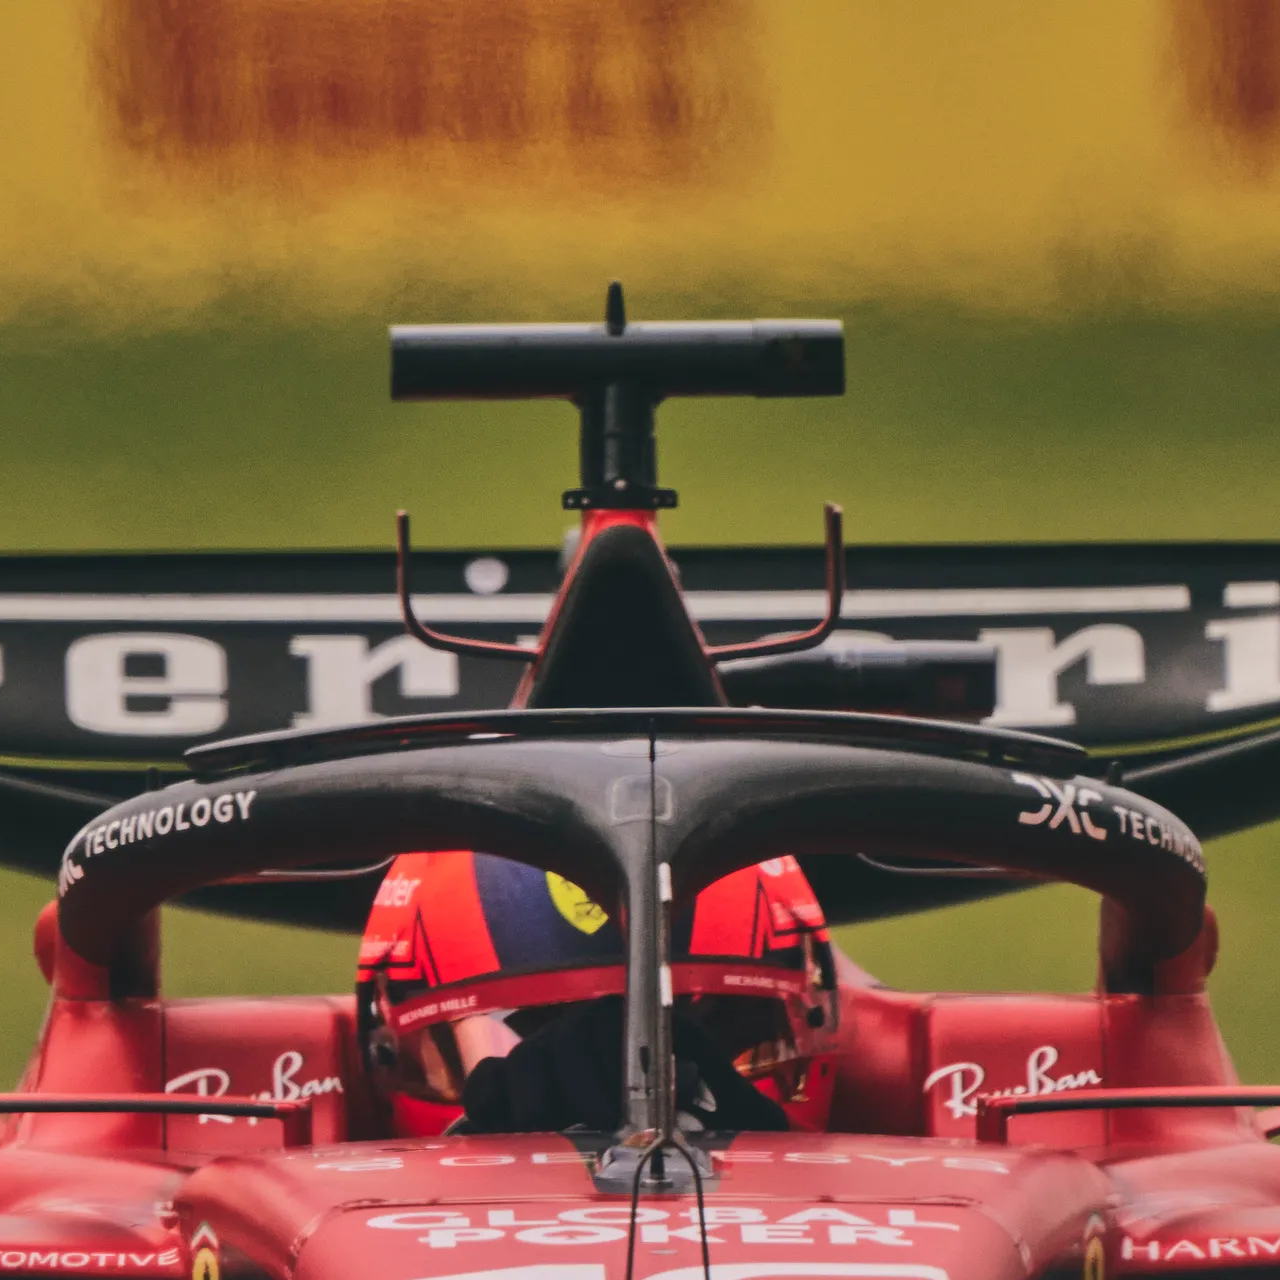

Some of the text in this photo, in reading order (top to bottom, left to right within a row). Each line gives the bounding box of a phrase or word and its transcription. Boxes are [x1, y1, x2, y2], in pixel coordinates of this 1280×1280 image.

[84, 790, 257, 858] TECHNOLOGY
[366, 1206, 961, 1232] GLOBAL
[417, 1224, 914, 1249] POKER
